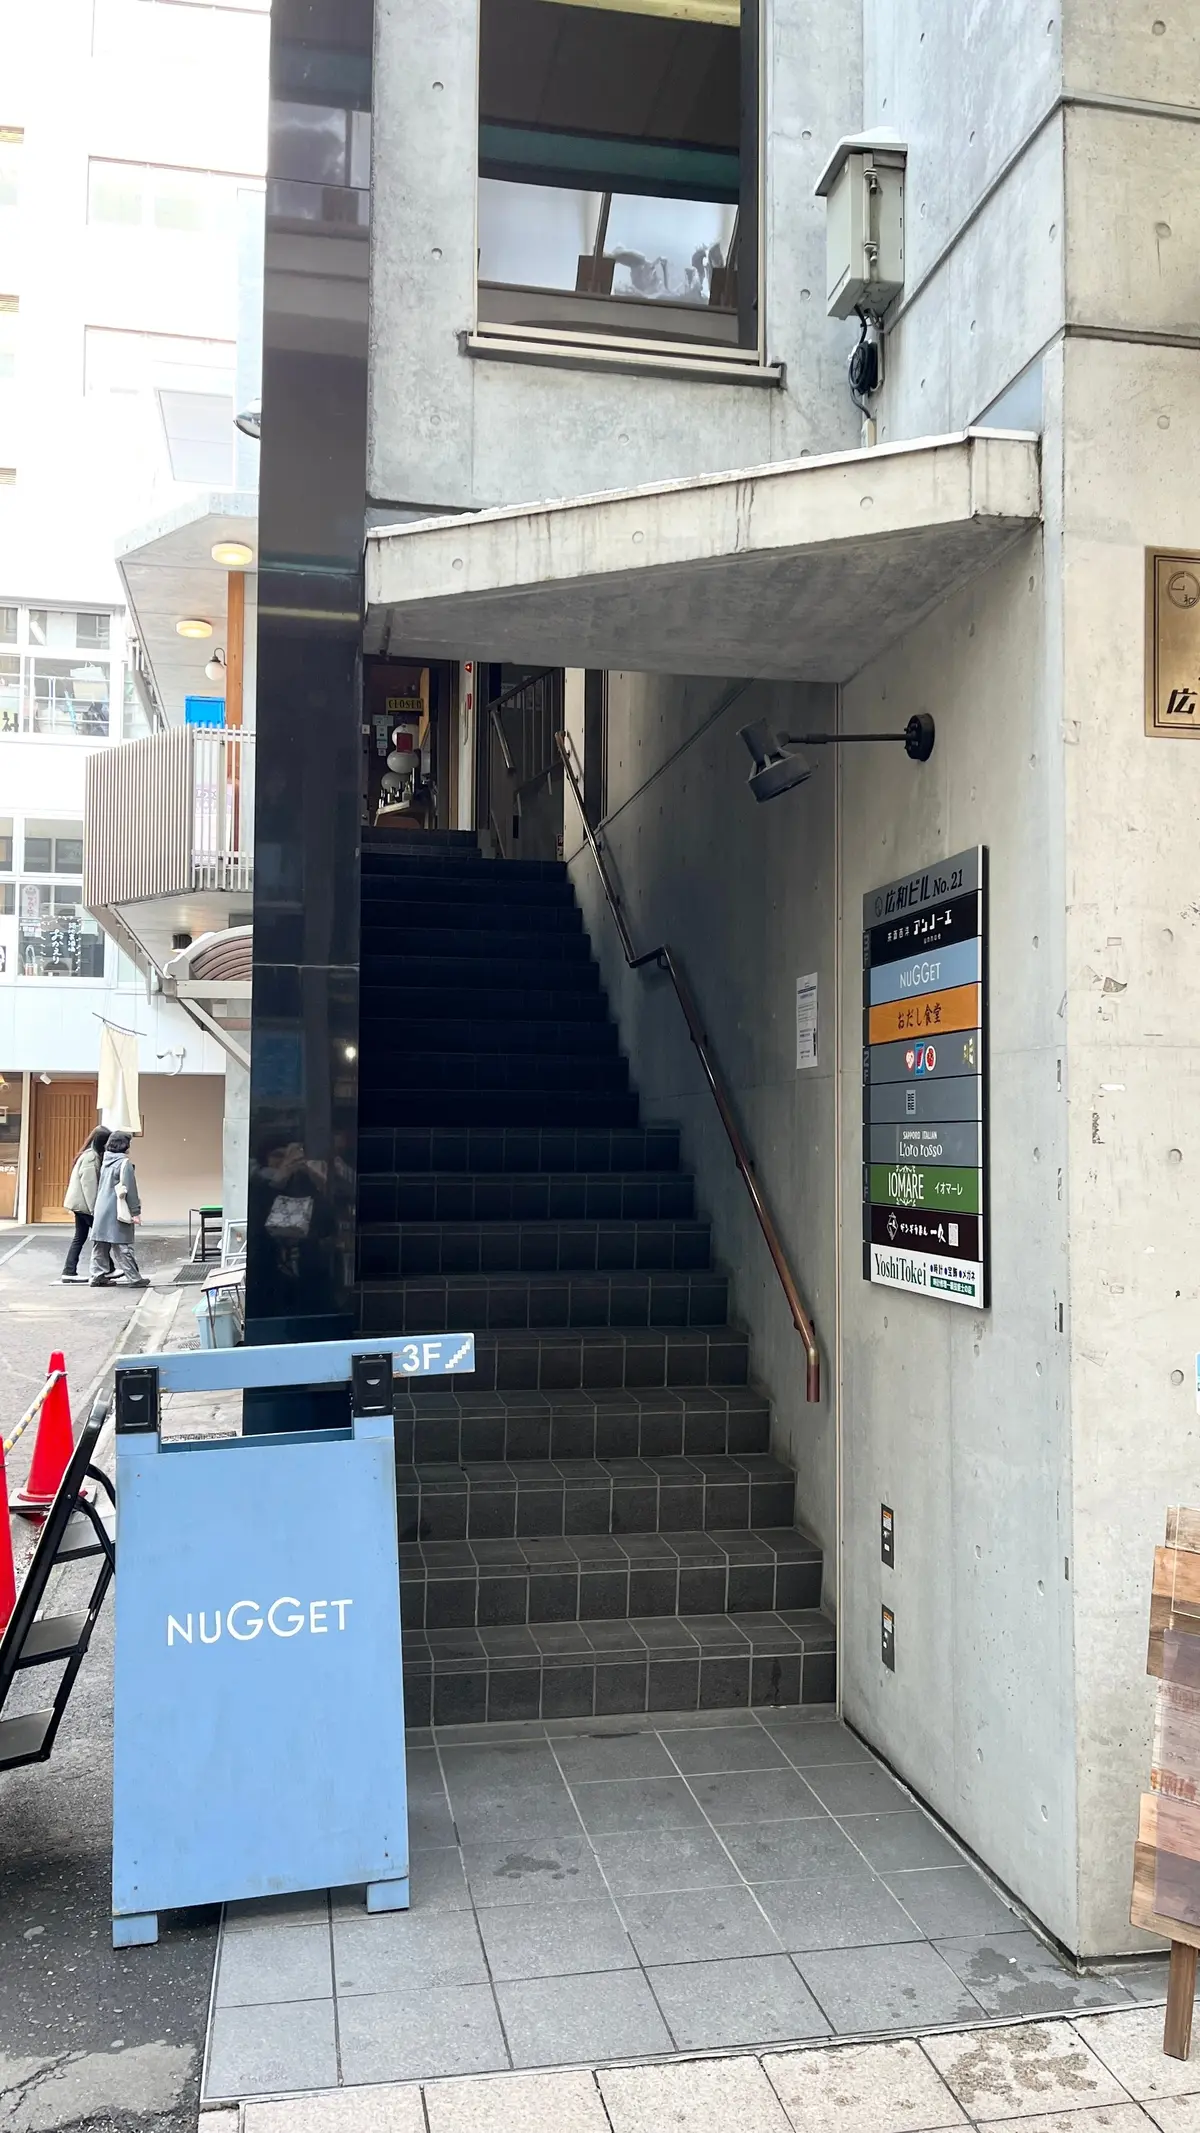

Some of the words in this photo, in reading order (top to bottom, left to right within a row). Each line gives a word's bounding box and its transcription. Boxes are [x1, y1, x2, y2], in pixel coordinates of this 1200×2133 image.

[388, 699, 422, 709] CLOSED
[885, 874, 930, 915] 広和ビル
[49, 929, 65, 964] おかえり
[900, 962, 941, 988] NUGGET
[898, 1002, 941, 1029] おだし食堂
[902, 1131, 920, 1140] SAPPORO
[922, 1131, 938, 1140] ITALIAN
[920, 1144, 943, 1158] rosso
[888, 1172, 924, 1200] IOMARE
[934, 1182, 963, 1196] イオマーレ
[874, 1253, 927, 1287] YoshiTokei
[962, 1270, 975, 1281] メガネ
[402, 1343, 442, 1373] 3F
[167, 1597, 353, 1646] NUGGET
